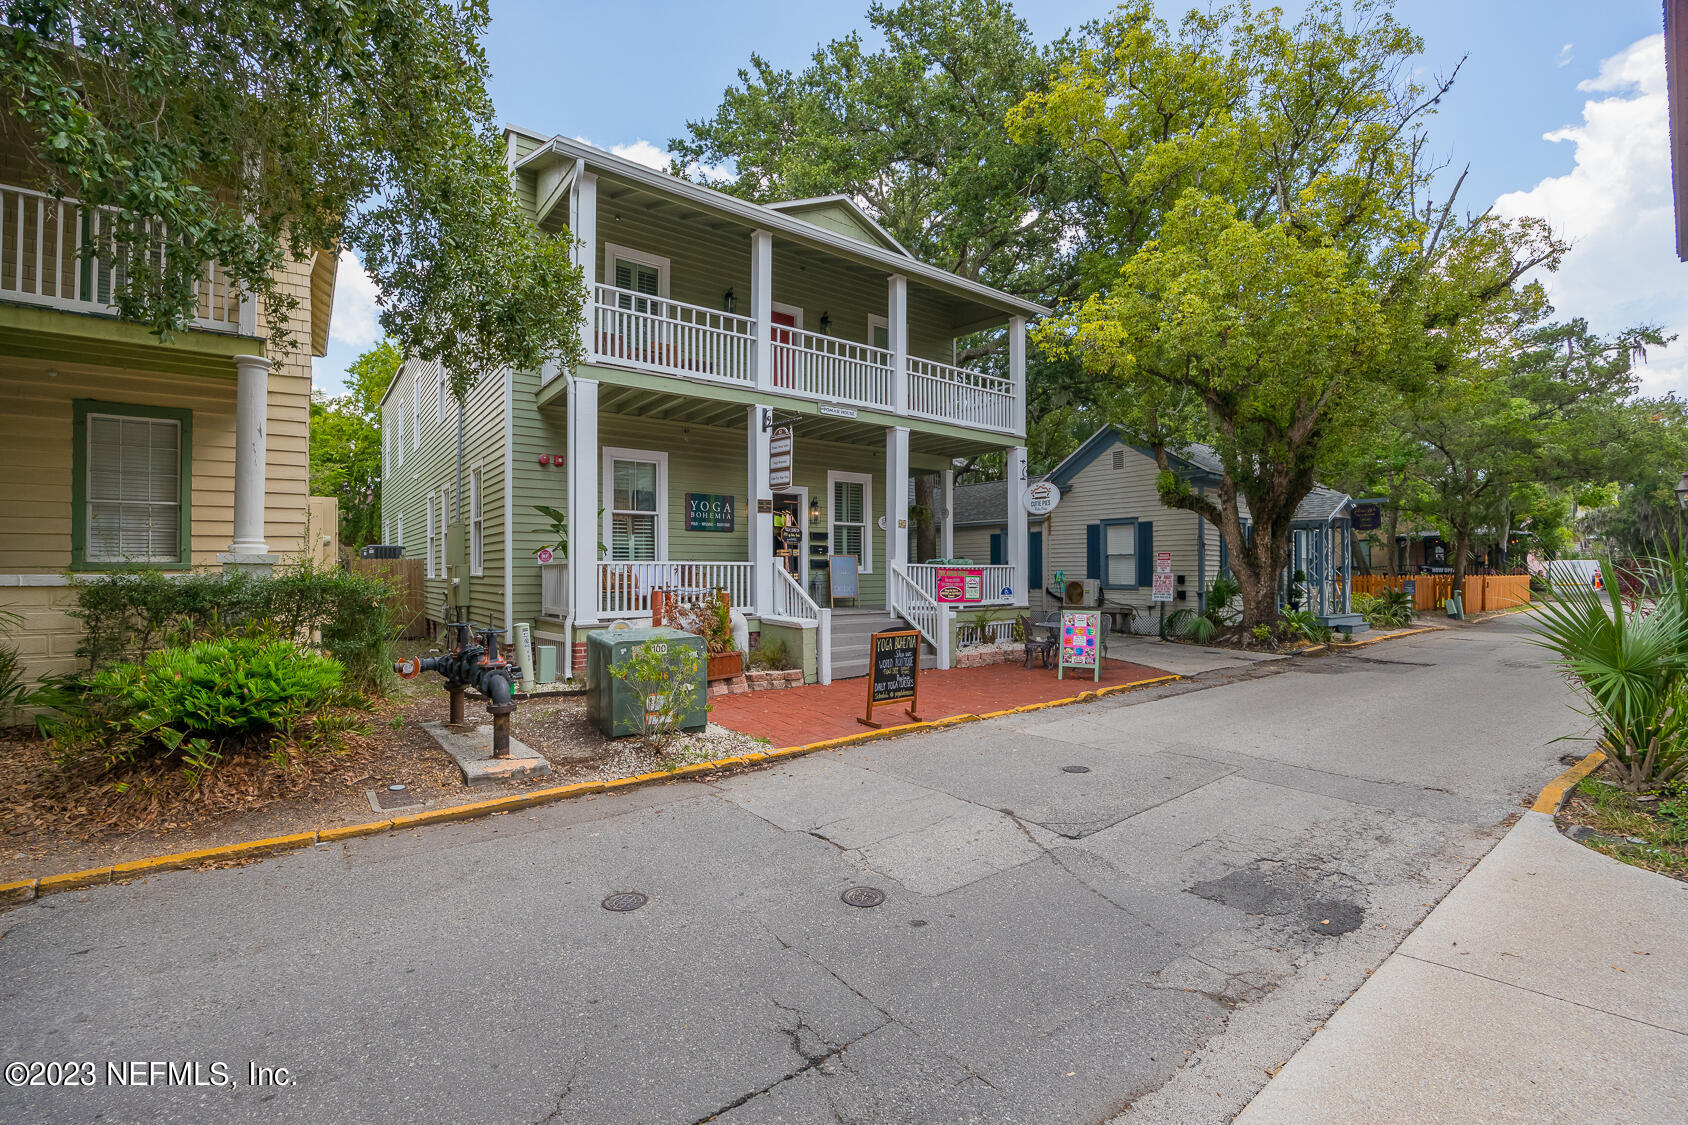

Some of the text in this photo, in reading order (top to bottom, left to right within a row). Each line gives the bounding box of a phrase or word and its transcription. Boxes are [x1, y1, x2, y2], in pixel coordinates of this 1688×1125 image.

[690, 500, 731, 513] YOGA
[690, 511, 731, 520] BOHEMIA
[652, 644, 666, 653] 100
[877, 635, 917, 652] YOGA BOHEMIA
[874, 681, 886, 692] DAILY
[887, 679, 898, 691] YOGA
